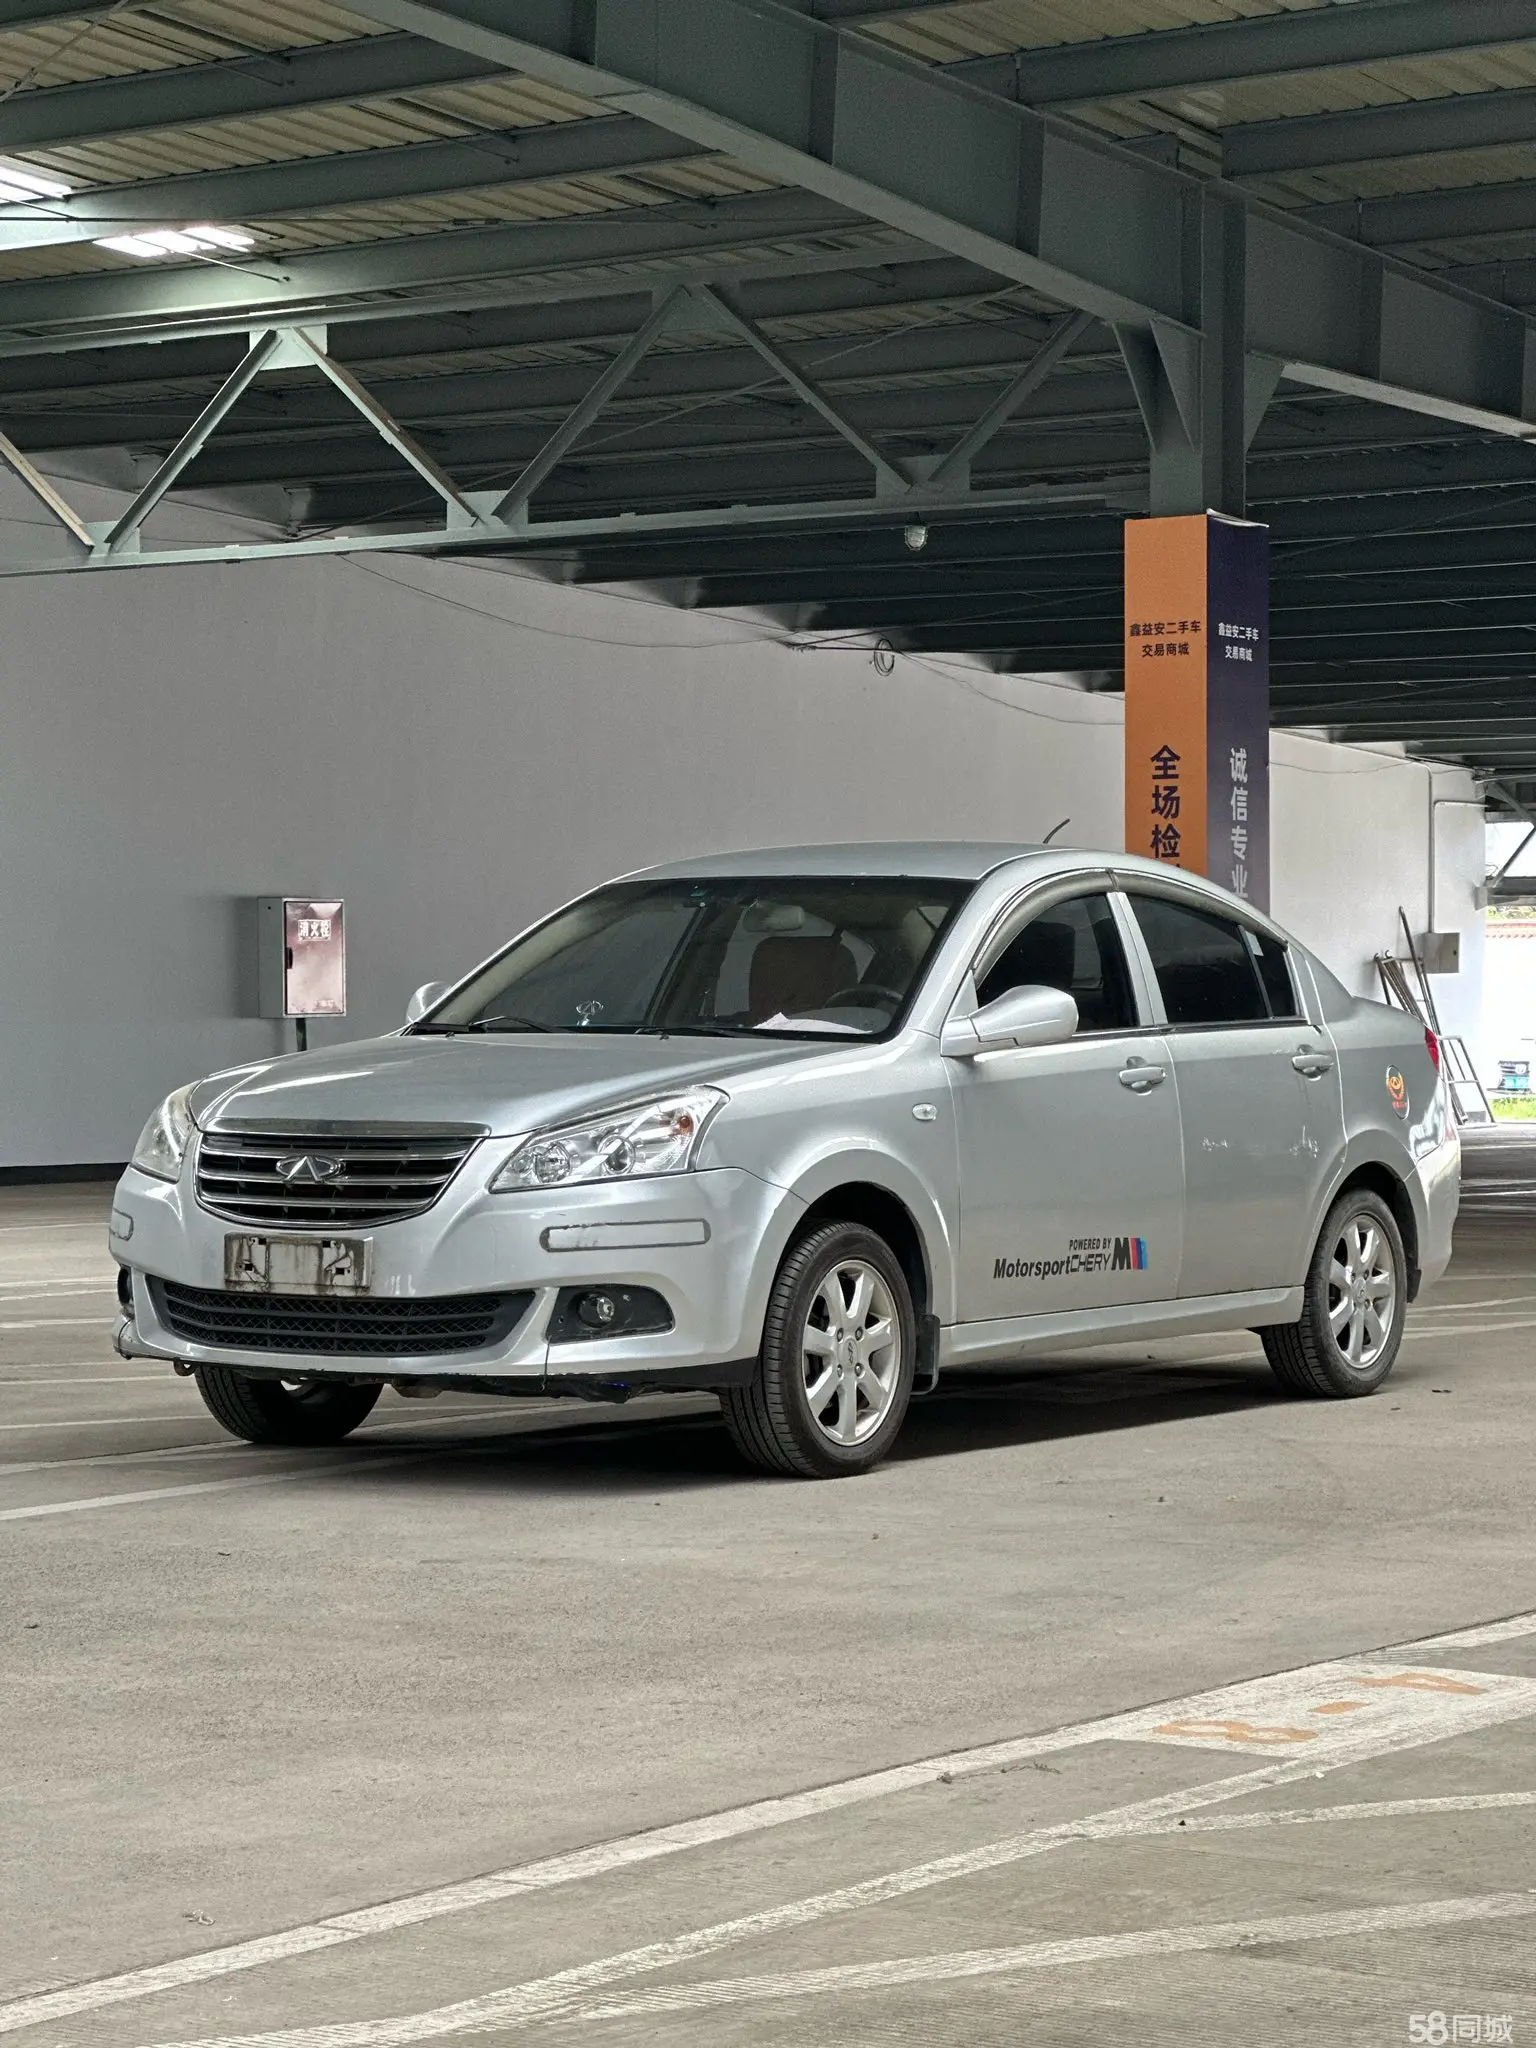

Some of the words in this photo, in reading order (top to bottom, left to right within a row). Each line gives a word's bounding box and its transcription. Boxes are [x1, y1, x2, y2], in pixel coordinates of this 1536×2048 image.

[1130, 620, 1201, 637] 鑫益安二手车
[1142, 642, 1189, 658] 交易商城
[1225, 645, 1252, 661] 交易商城
[1150, 744, 1181, 869] 全场检
[1069, 1239, 1100, 1250] POWERED
[1102, 1237, 1112, 1249] BY
